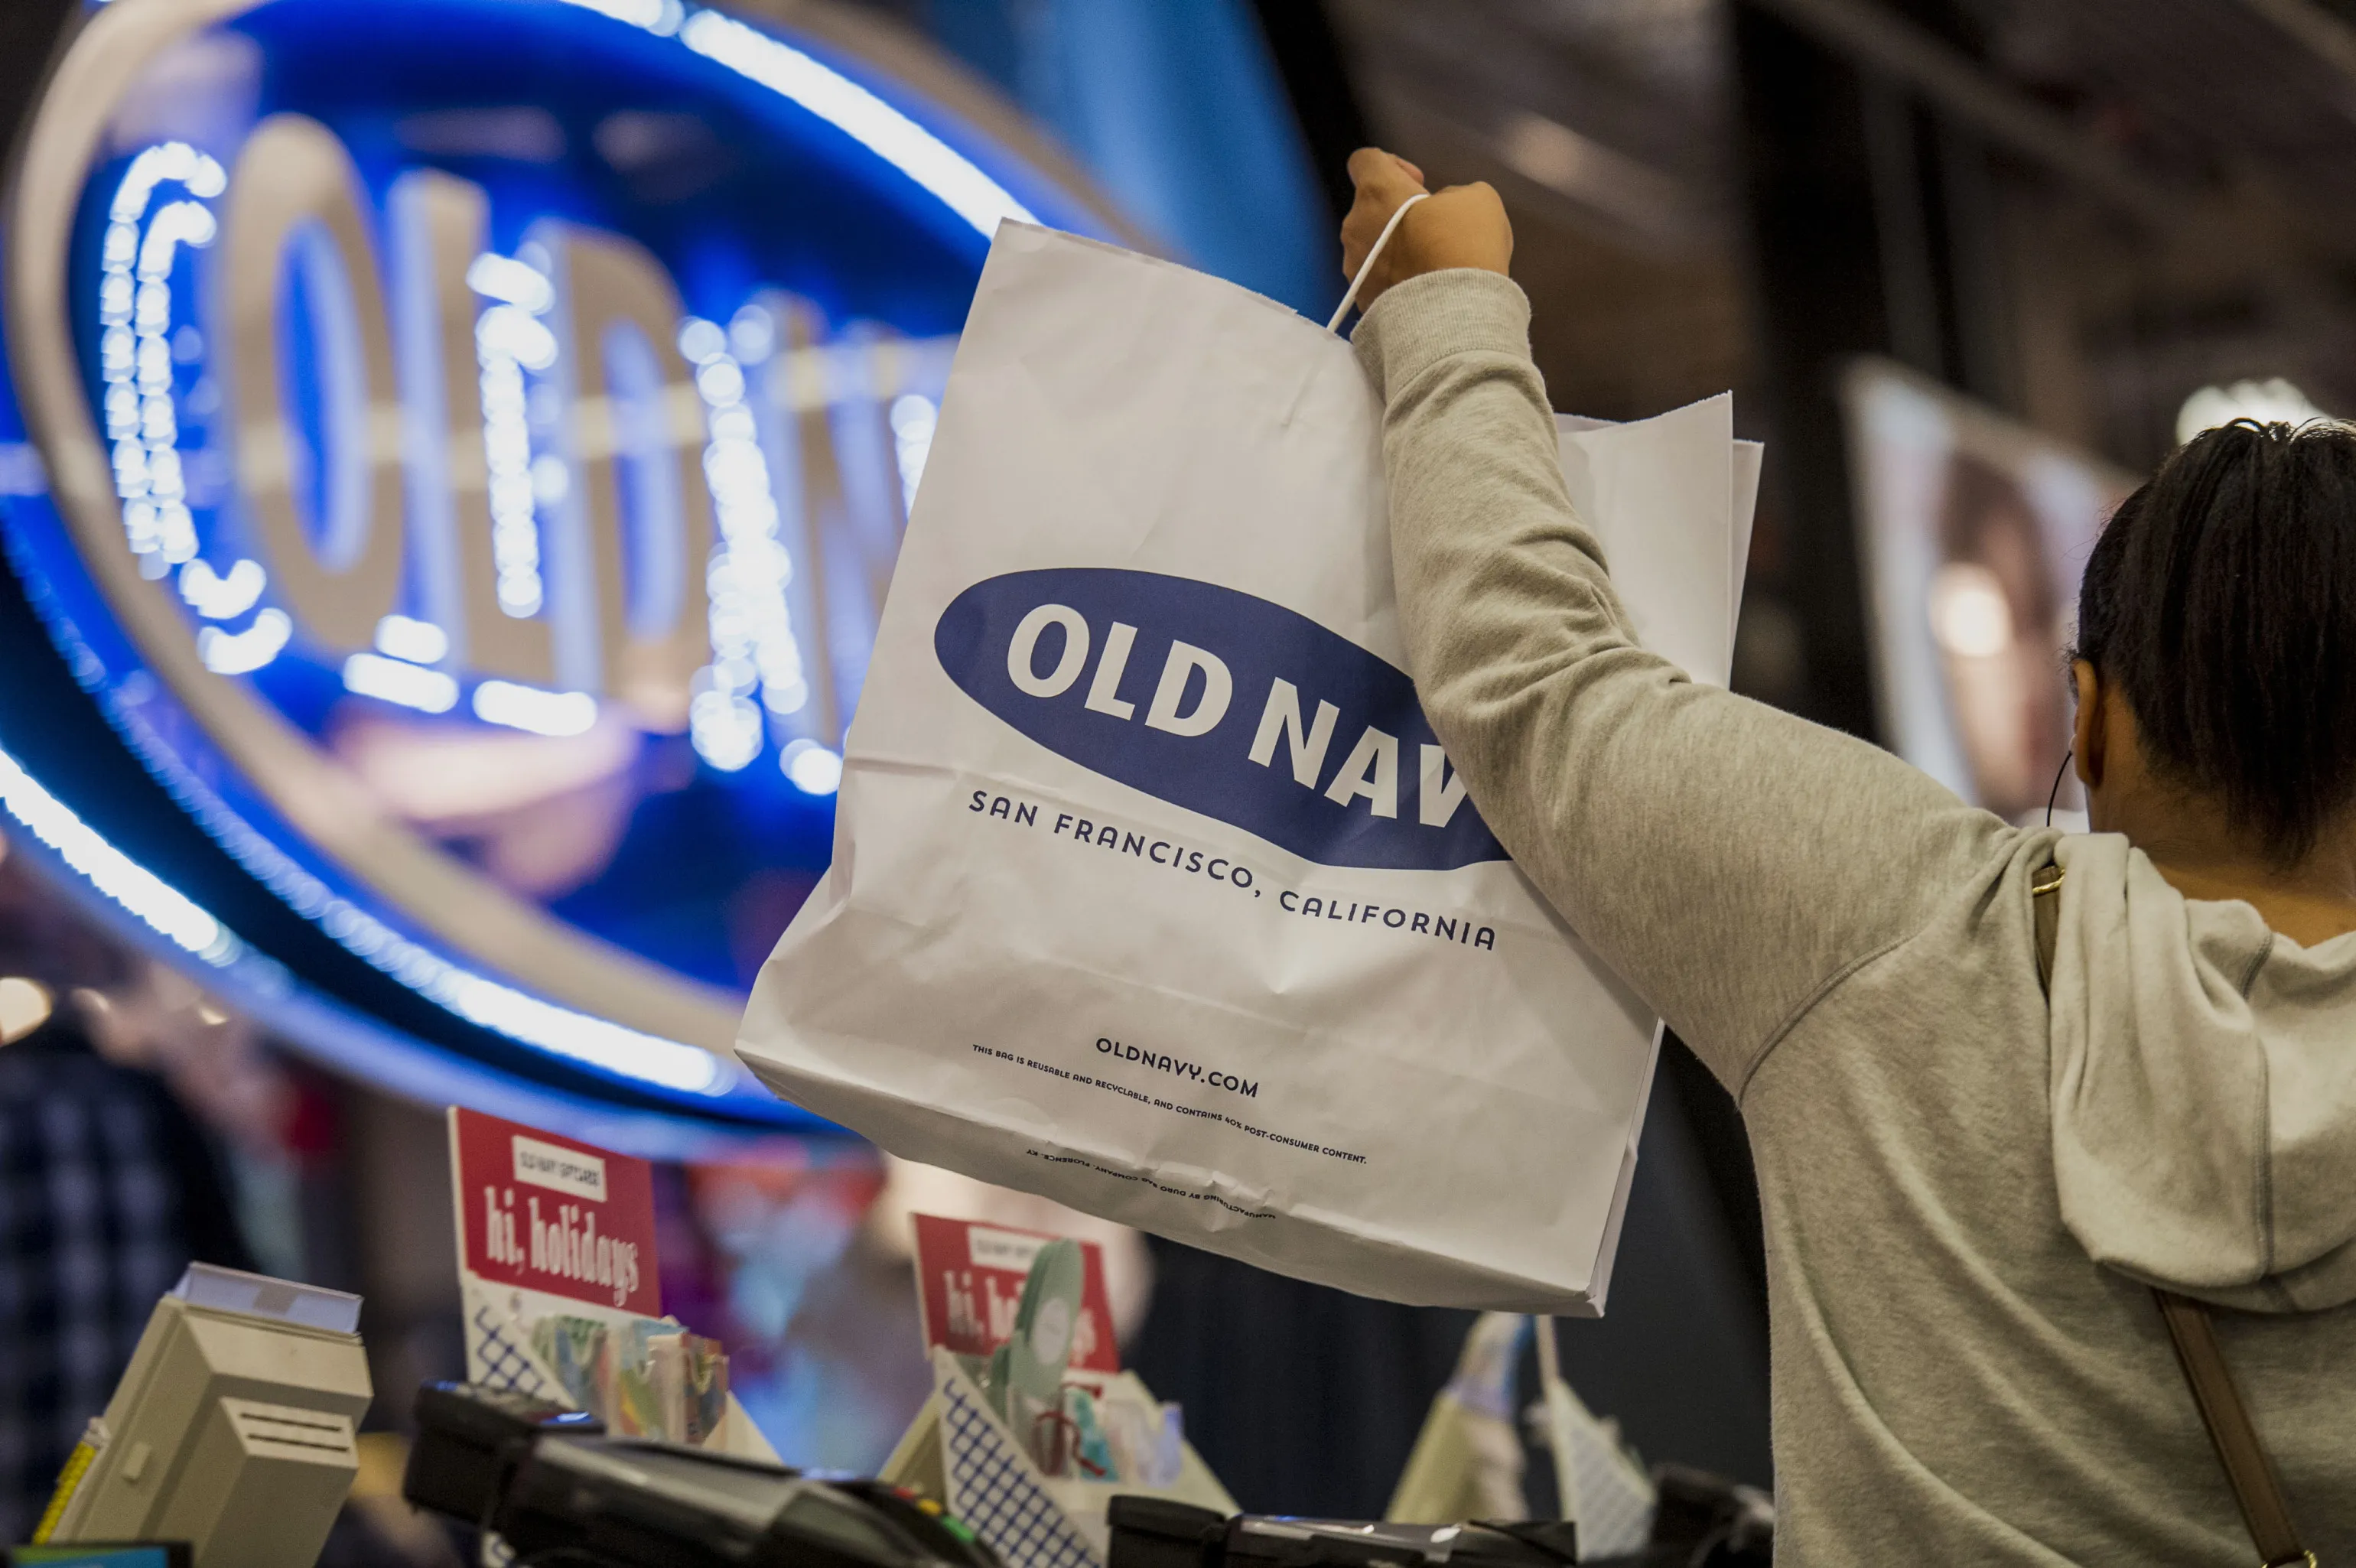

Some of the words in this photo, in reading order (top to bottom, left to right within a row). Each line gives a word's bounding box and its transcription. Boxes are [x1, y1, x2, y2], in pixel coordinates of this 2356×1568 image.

[1007, 603, 1233, 737] OLD
[1248, 676, 1470, 829] NAV
[968, 789, 1039, 828] SAN
[1053, 812, 1262, 898] FRANCISCO,
[1279, 890, 1496, 952] CALIFORNIA
[972, 1044, 993, 1056] THIS
[995, 1050, 1014, 1062] BAG
[1016, 1056, 1025, 1065] IS
[1027, 1059, 1071, 1079] REUSABLE
[1072, 1074, 1093, 1085] AND
[1095, 1079, 1151, 1105] RECYCLABLE,
[1154, 1099, 1173, 1111] AND
[1176, 1105, 1223, 1121] CONTAINS
[1225, 1117, 1242, 1130] 40%
[1244, 1125, 1320, 1153] POST-CONSUMER
[1322, 1147, 1367, 1164] CONTENT.
[1095, 1037, 1259, 1098] OLDNAVY.COM
[1141, 1177, 1158, 1189] BAG
[1160, 1186, 1186, 1197] DURO
[1188, 1192, 1202, 1201] BY
[484, 1186, 526, 1277] hi,
[528, 1196, 639, 1308] holidays
